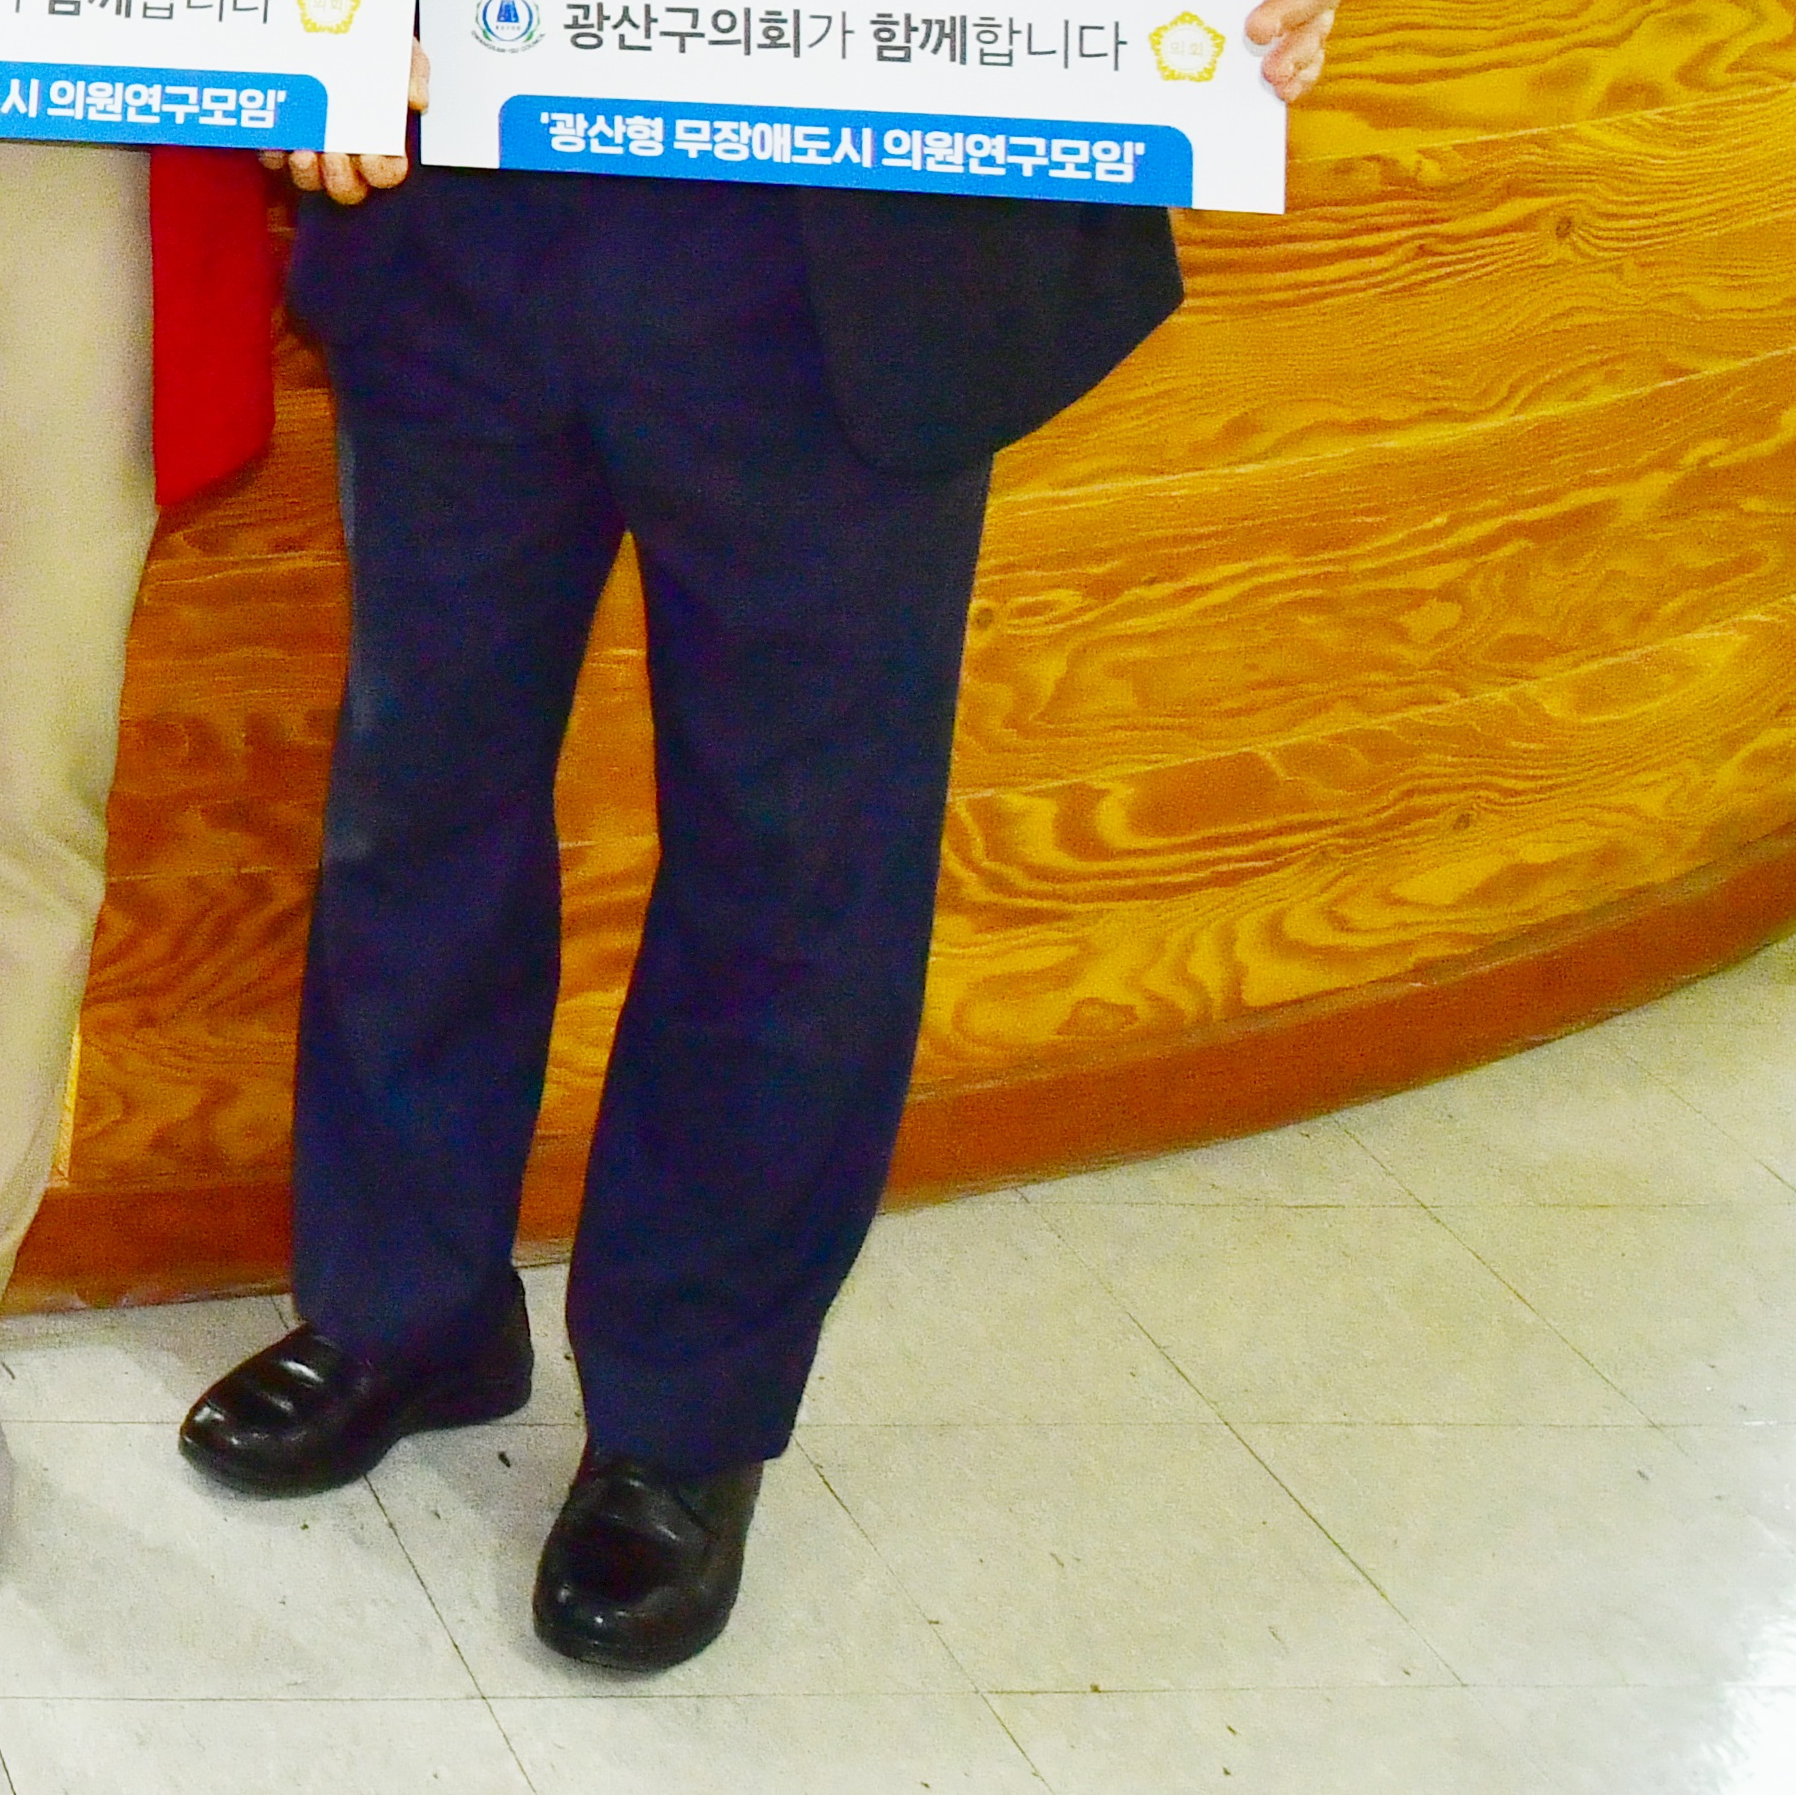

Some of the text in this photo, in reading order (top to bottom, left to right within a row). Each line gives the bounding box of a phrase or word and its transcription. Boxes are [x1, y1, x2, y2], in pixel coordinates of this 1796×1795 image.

[563, 1, 1128, 72] 광산구의회가 함께합니다
[46, 80, 287, 129] 의원연구모임'
[540, 111, 1146, 184] '광산형 무장애도시 의원연구모임'
